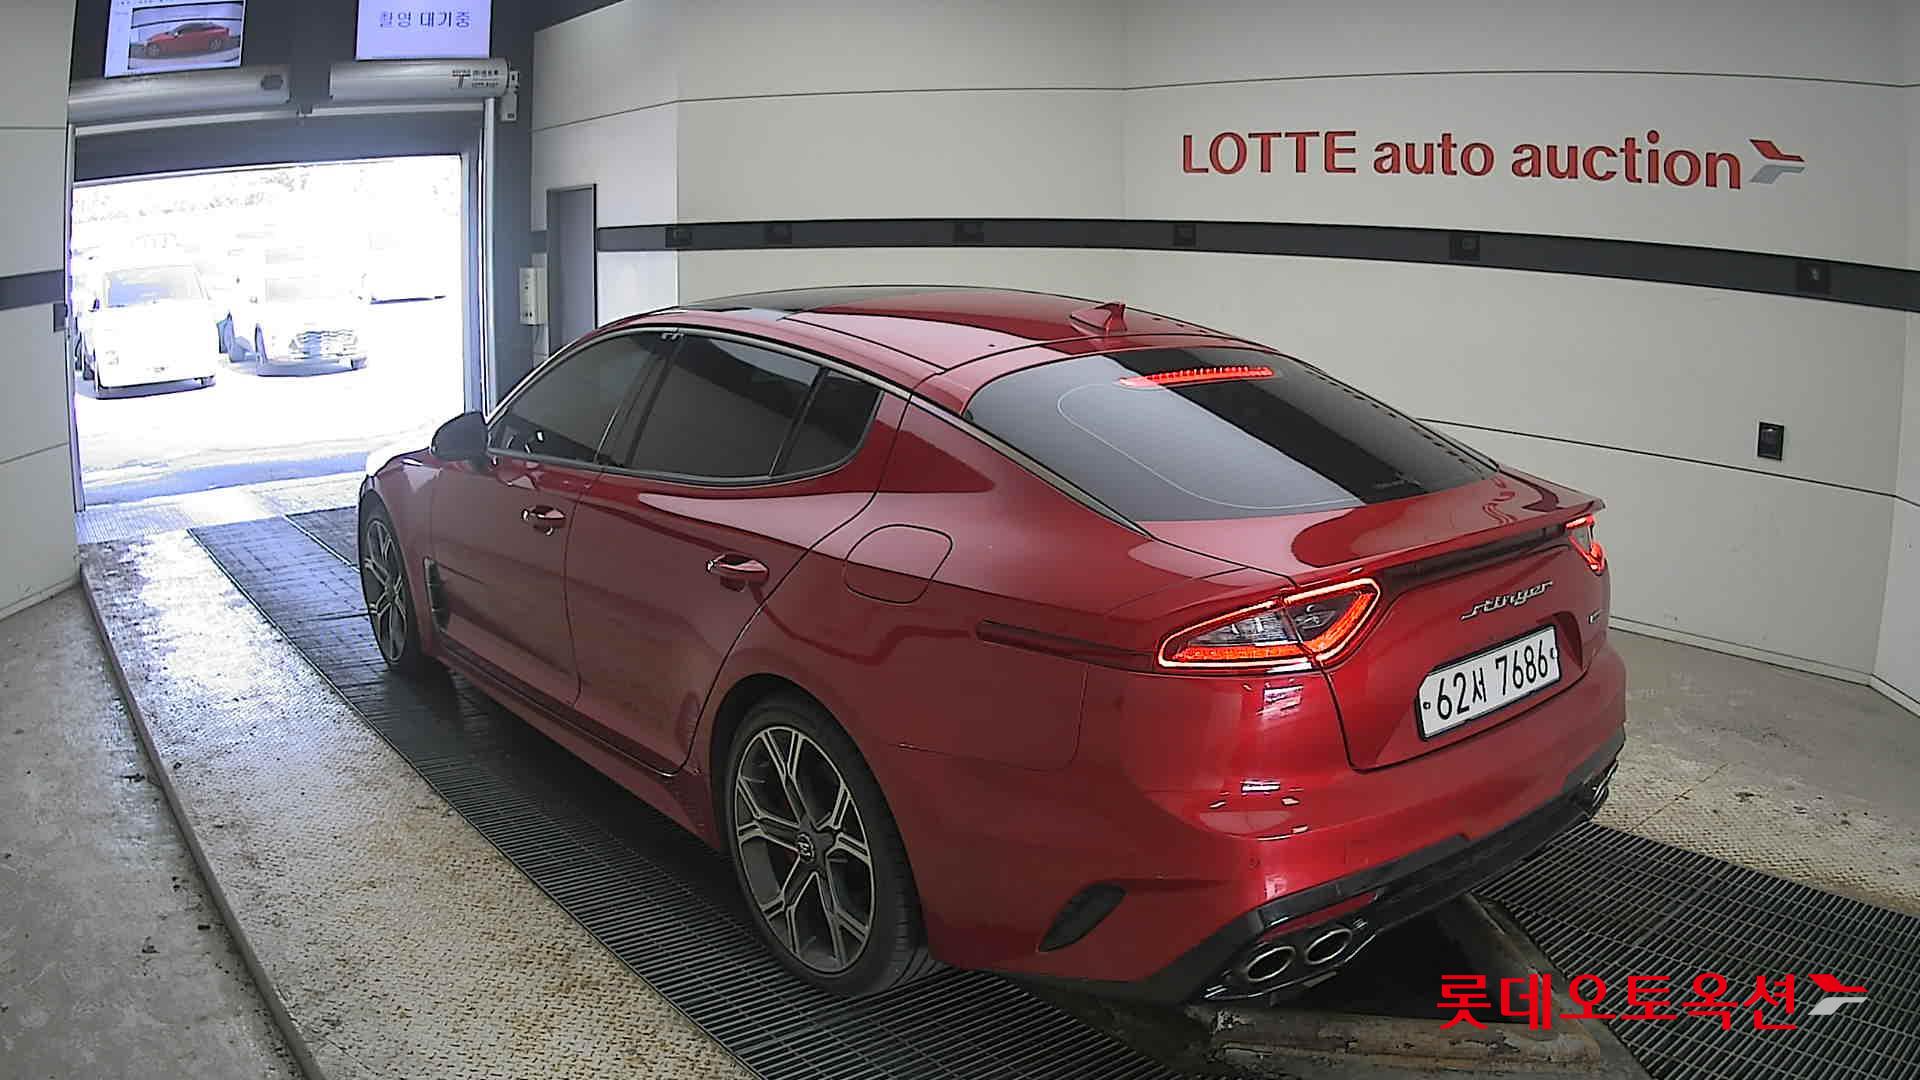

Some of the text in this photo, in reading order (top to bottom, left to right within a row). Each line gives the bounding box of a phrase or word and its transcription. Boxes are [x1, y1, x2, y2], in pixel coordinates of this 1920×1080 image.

[419, 11, 471, 28] 대기중
[1182, 129, 1742, 189] LOTTE auto auction
[1436, 639, 1549, 720] 62서 7686
